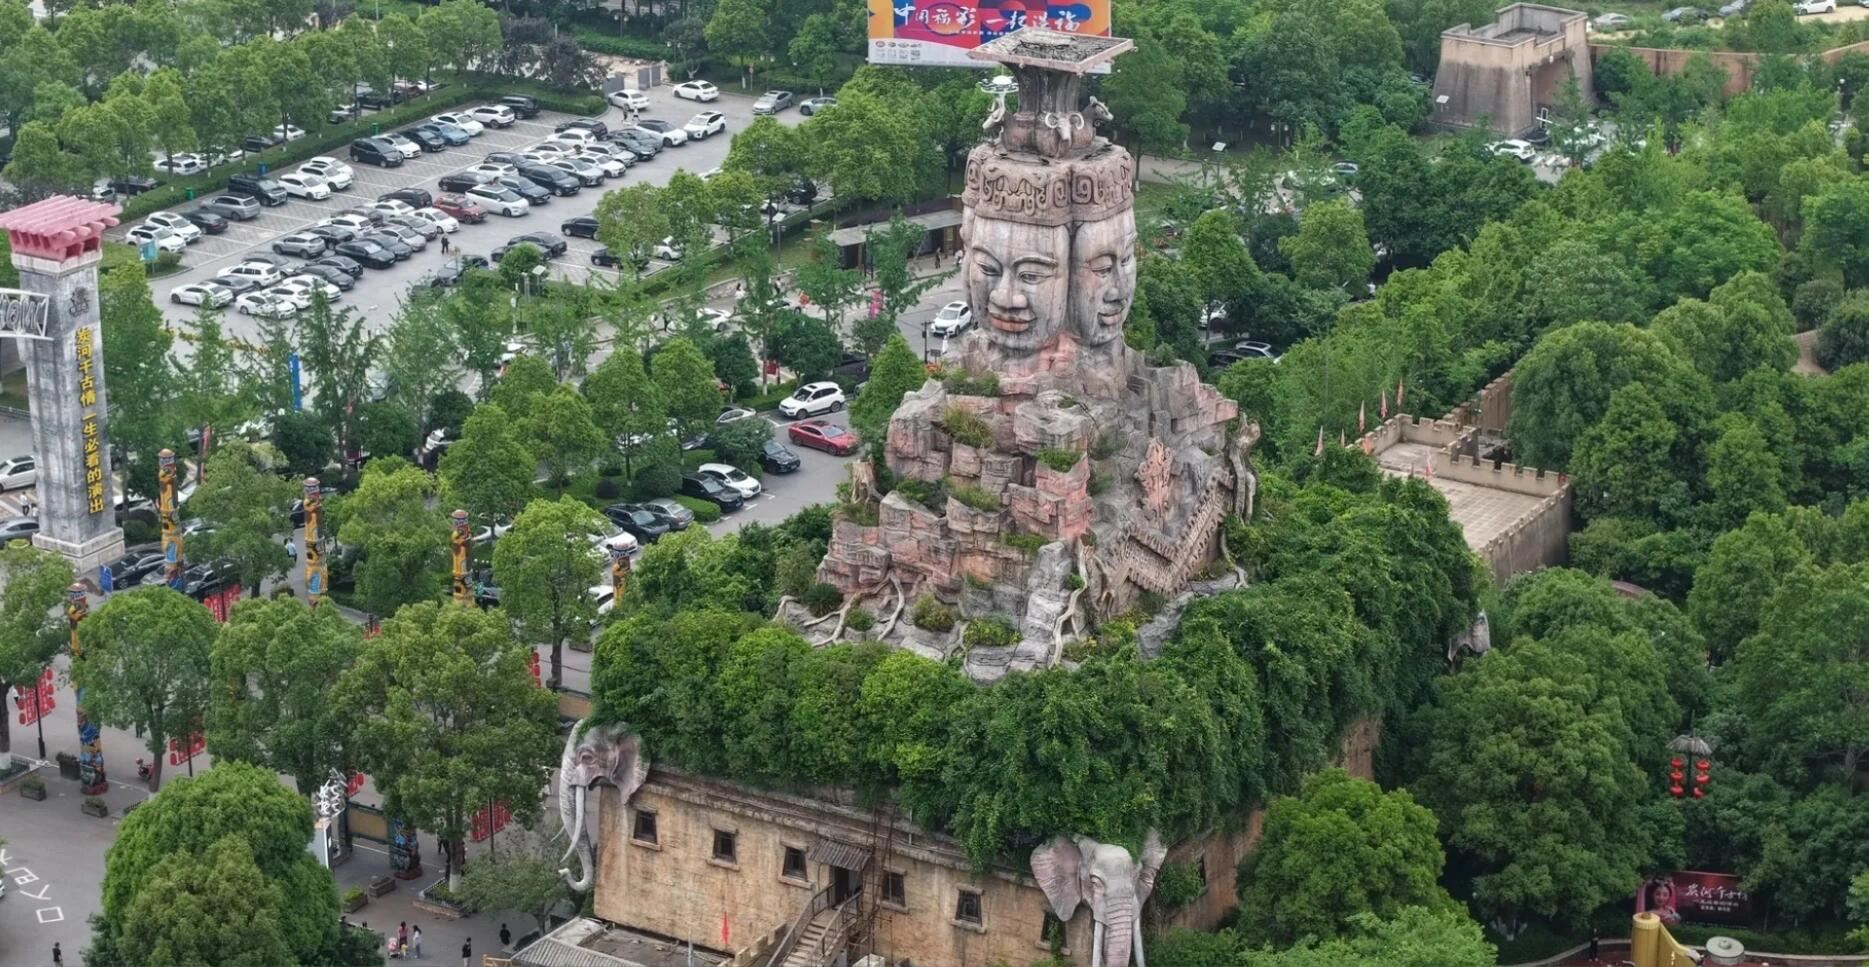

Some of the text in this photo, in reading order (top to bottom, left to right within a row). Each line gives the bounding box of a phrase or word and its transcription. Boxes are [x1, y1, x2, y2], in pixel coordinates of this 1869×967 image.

[895, 5, 977, 28] 中国福彩
[77, 328, 103, 514] 炭河千古情 一生必看的演出
